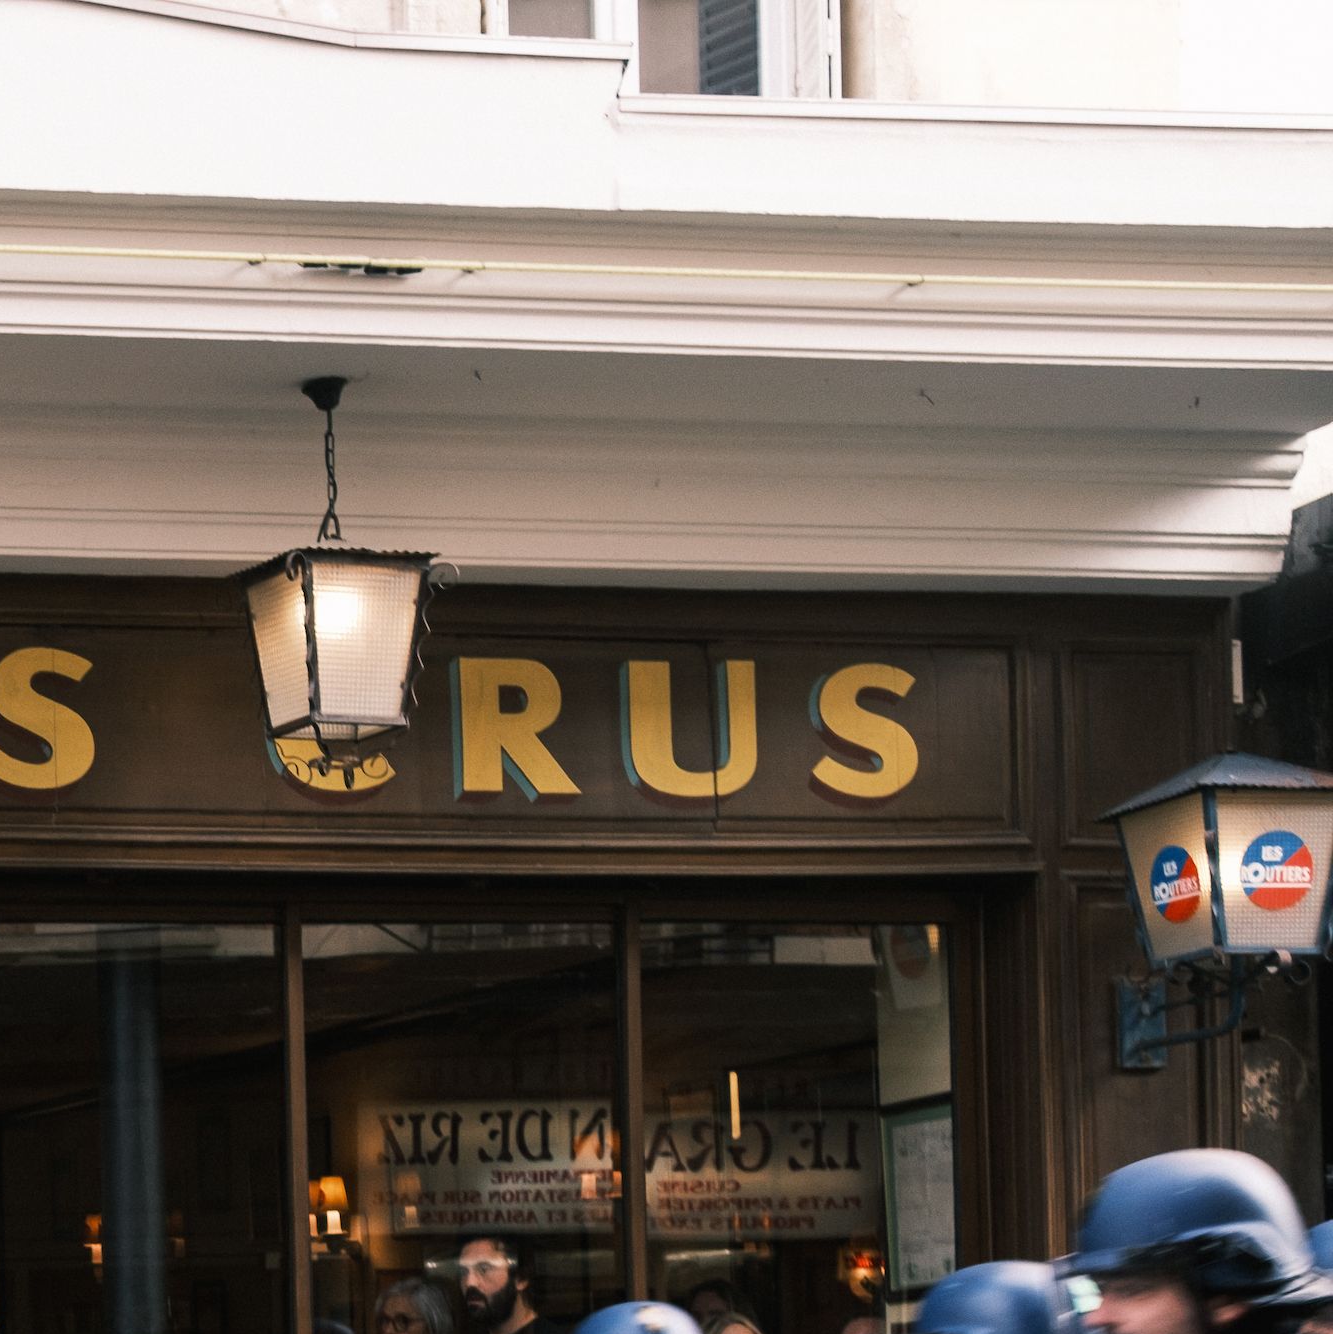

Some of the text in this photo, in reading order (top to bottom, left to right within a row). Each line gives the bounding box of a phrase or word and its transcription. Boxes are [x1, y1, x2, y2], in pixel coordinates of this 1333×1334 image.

[1262, 845, 1284, 860] LES
[1163, 860, 1178, 876] LES
[1241, 864, 1311, 884] ROUTIERS
[1153, 877, 1200, 902] ROUTIERS
